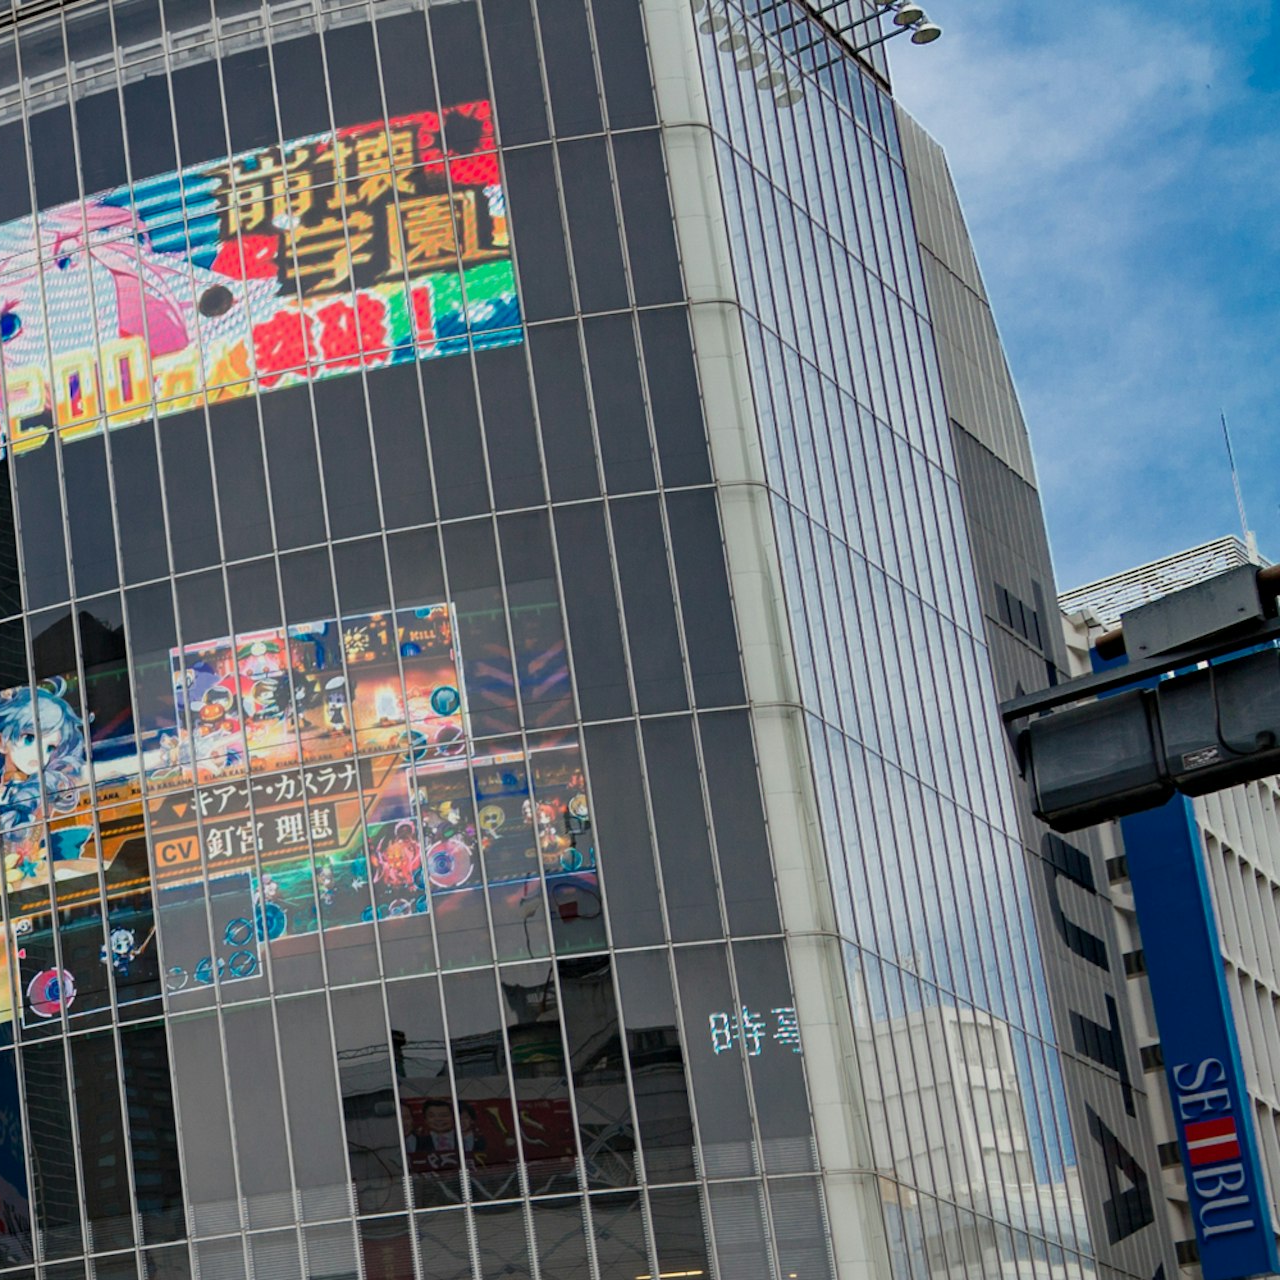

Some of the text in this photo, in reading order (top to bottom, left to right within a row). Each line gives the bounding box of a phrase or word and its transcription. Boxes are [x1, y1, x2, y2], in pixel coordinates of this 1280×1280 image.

[285, 192, 485, 292] 学園
[410, 630, 436, 641] KILL
[162, 841, 192, 863] CV
[1173, 1057, 1256, 1242] SEIBU
